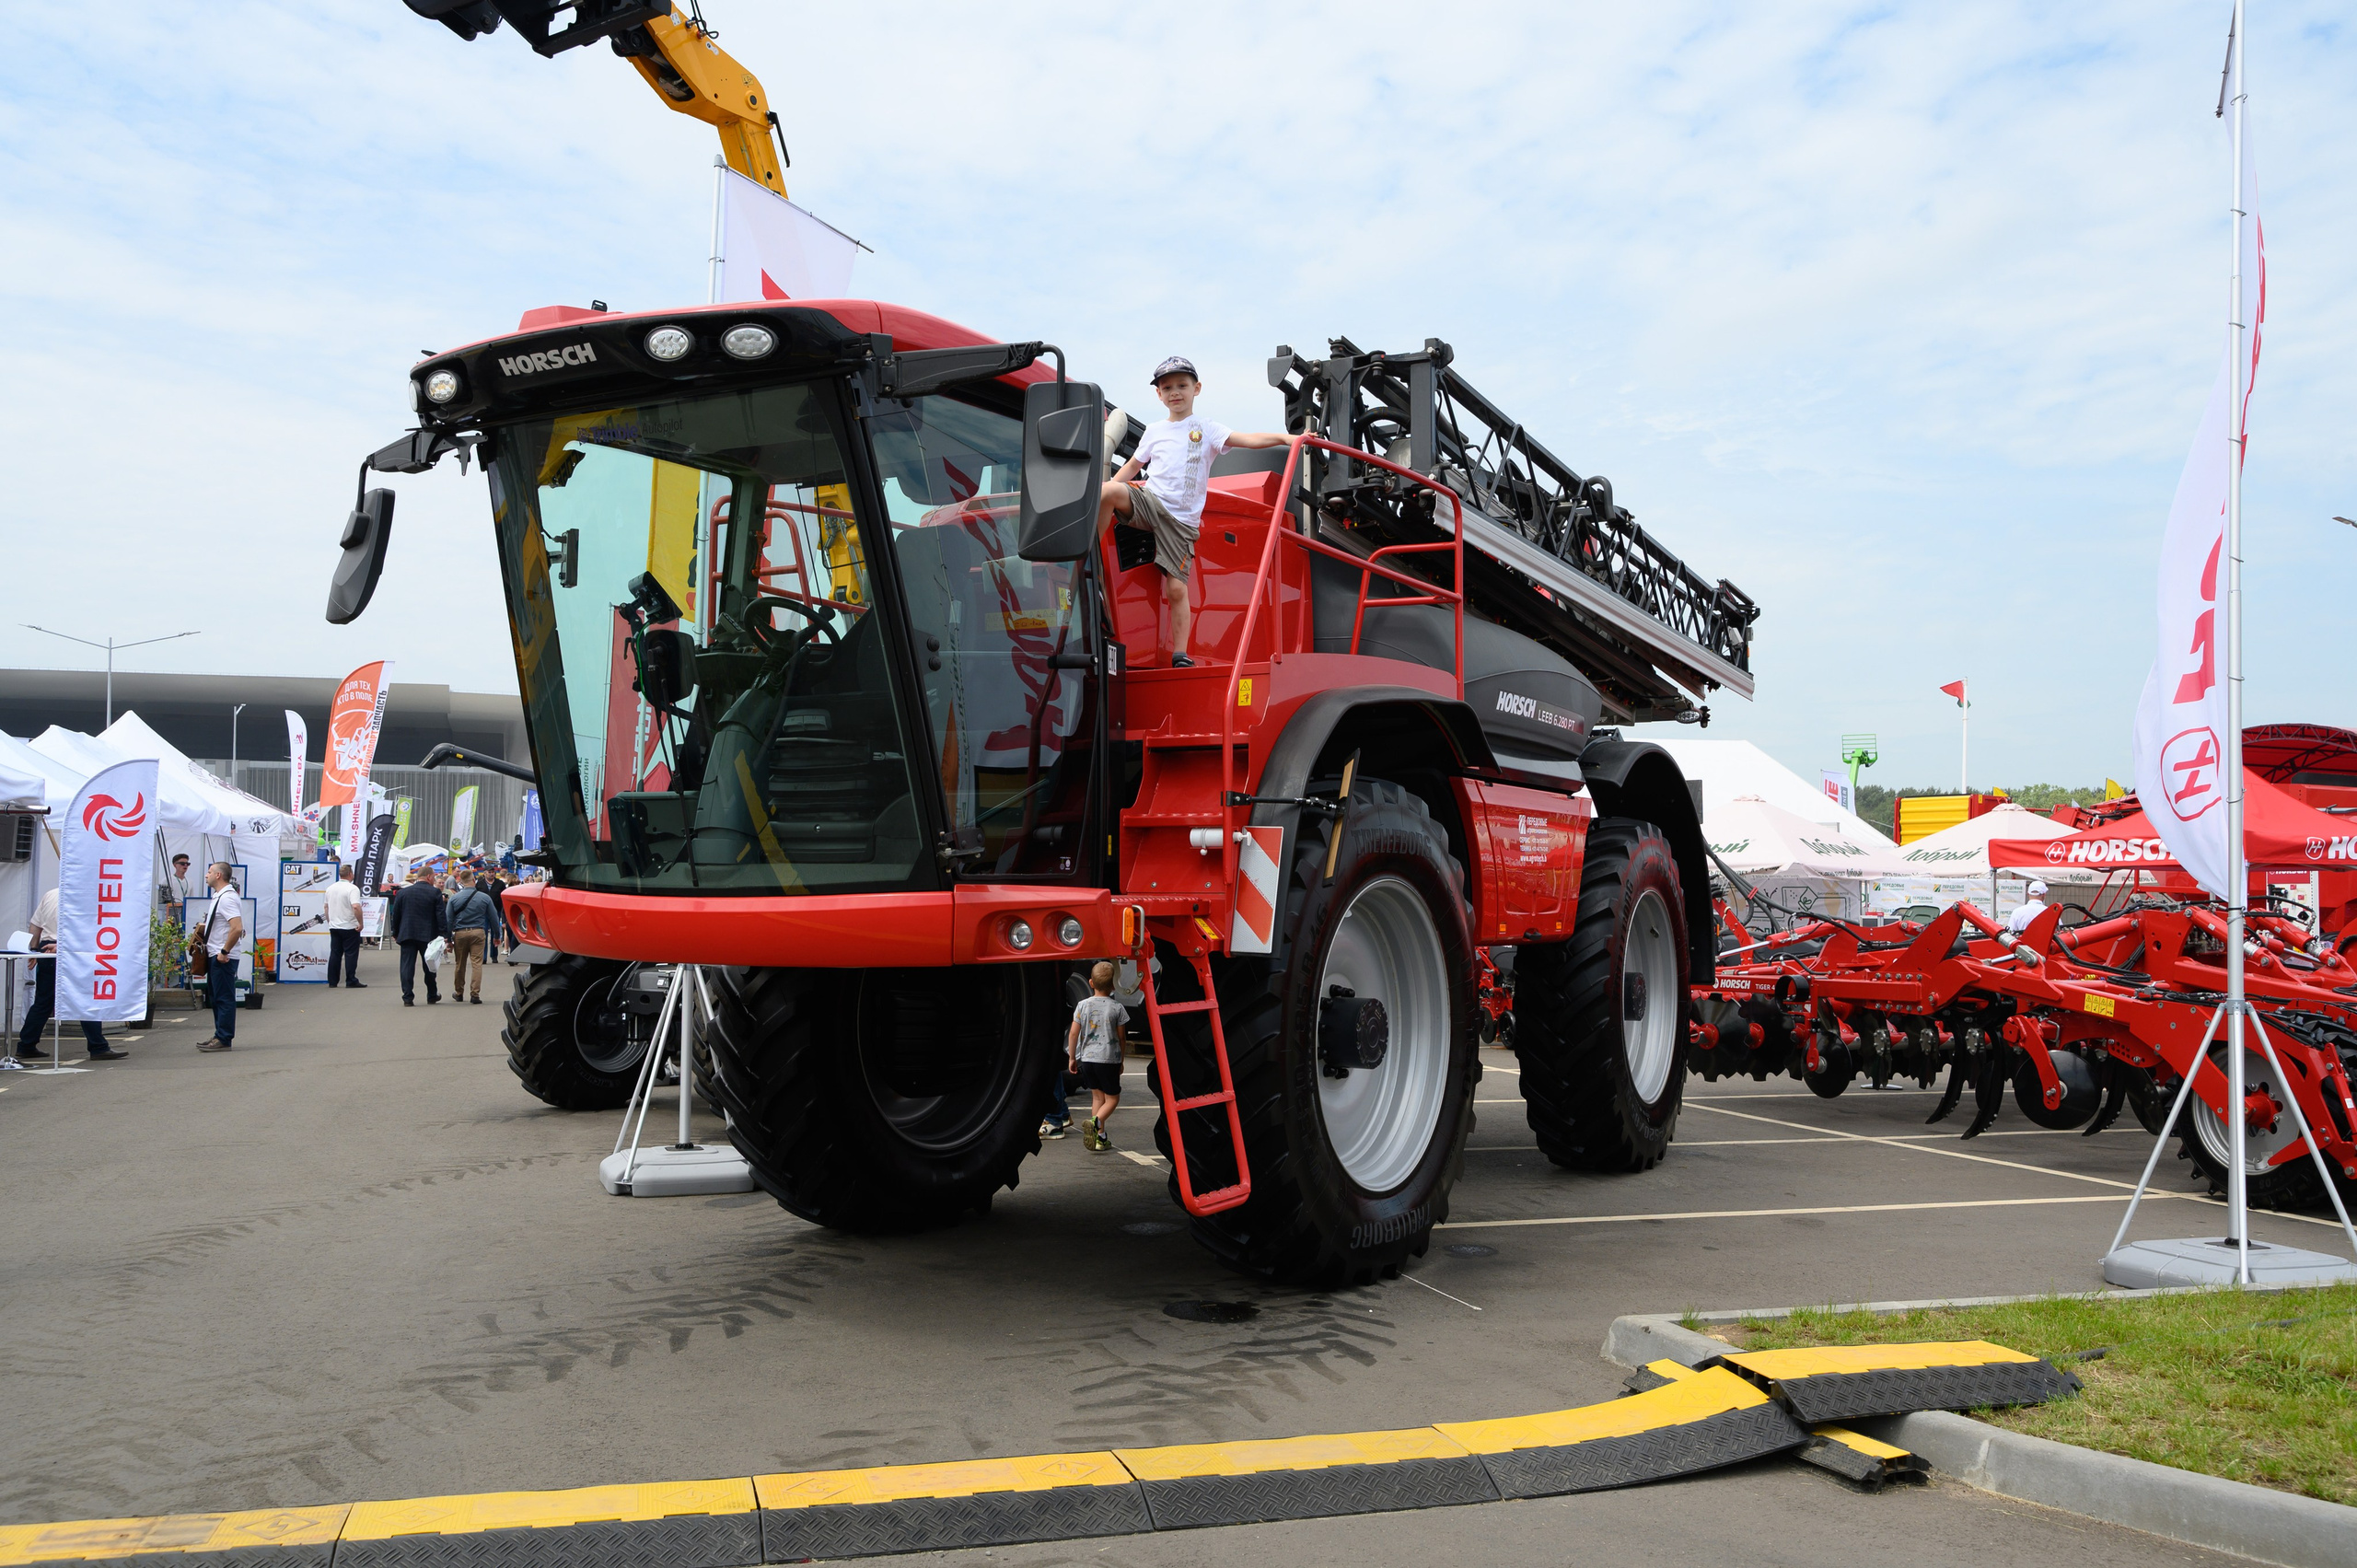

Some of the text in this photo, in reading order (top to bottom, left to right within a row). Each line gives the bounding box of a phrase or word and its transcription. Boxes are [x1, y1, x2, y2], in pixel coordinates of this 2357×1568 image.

[498, 342, 598, 377] HORSCH
[590, 417, 683, 444] Trimble Autopilot
[337, 691, 373, 706] КТО В ПОЛЕ
[344, 680, 371, 692] ДЛЯ ТЕХ
[1496, 691, 1576, 731] HORSCH LEEB 6.280 PT
[368, 827, 383, 859] ПАРК
[1350, 829, 1433, 858] TRELLEBORG
[284, 865, 301, 874] CAT
[284, 906, 300, 915] CAT
[93, 858, 124, 1001] БИОТЕП
[1720, 979, 1750, 989] HORSCH
[1350, 1203, 1431, 1249] TRELLEBORG
